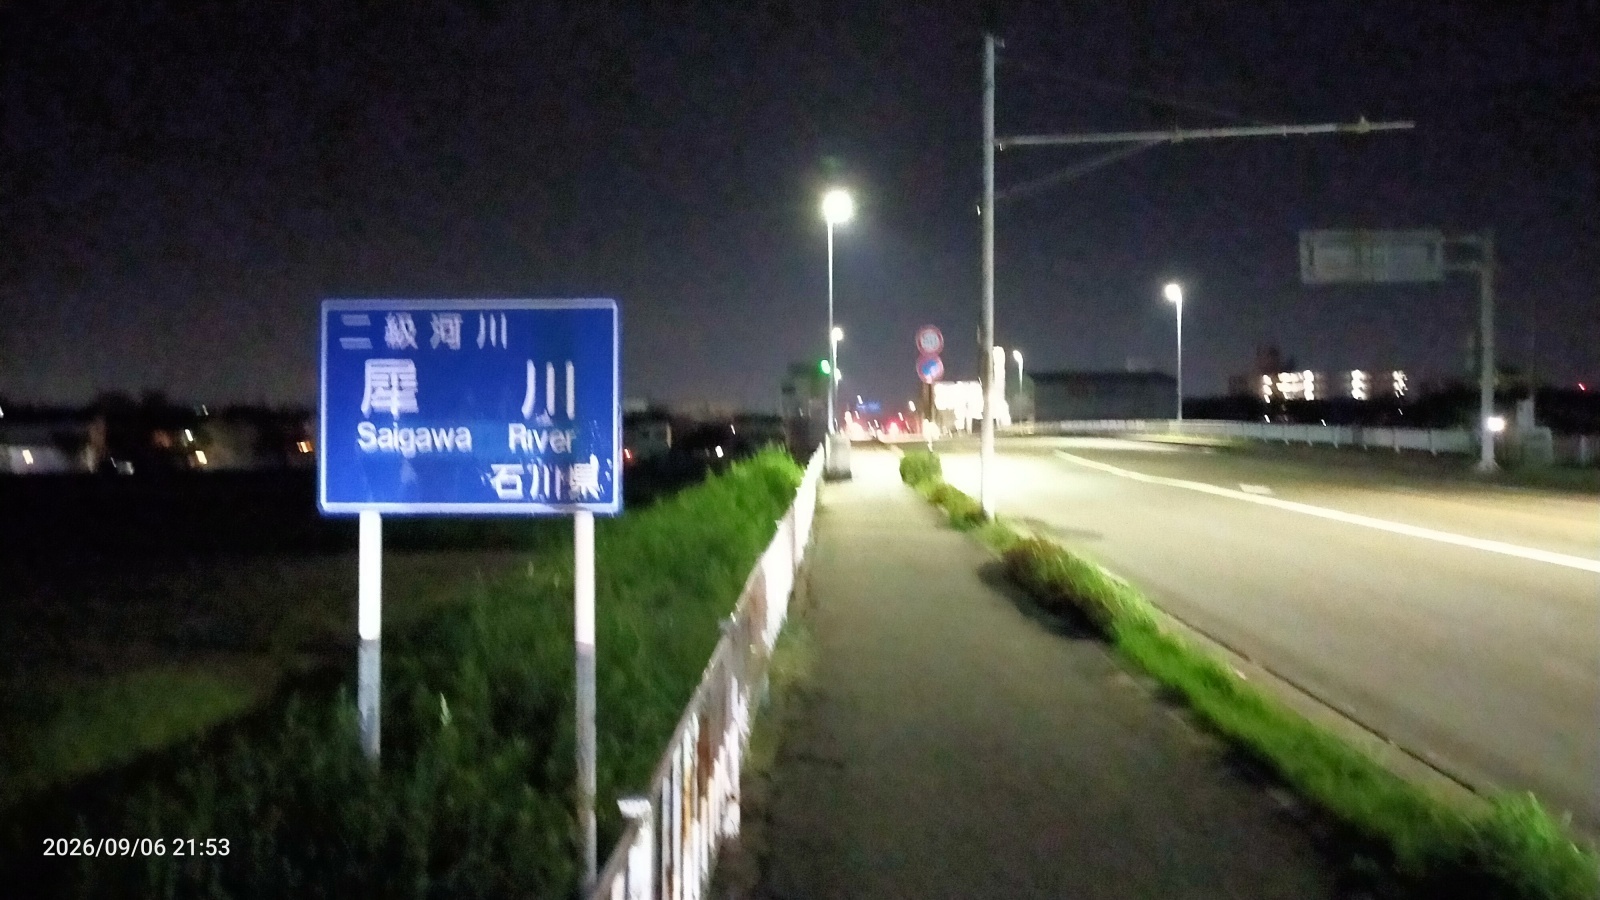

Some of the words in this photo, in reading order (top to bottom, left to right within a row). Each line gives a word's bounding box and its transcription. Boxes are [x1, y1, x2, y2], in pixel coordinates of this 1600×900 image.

[339, 312, 508, 349] 二級河川
[361, 358, 575, 420] 犀川
[357, 420, 472, 459] Saigawa
[508, 422, 575, 454] River
[491, 461, 601, 501] 石川県
